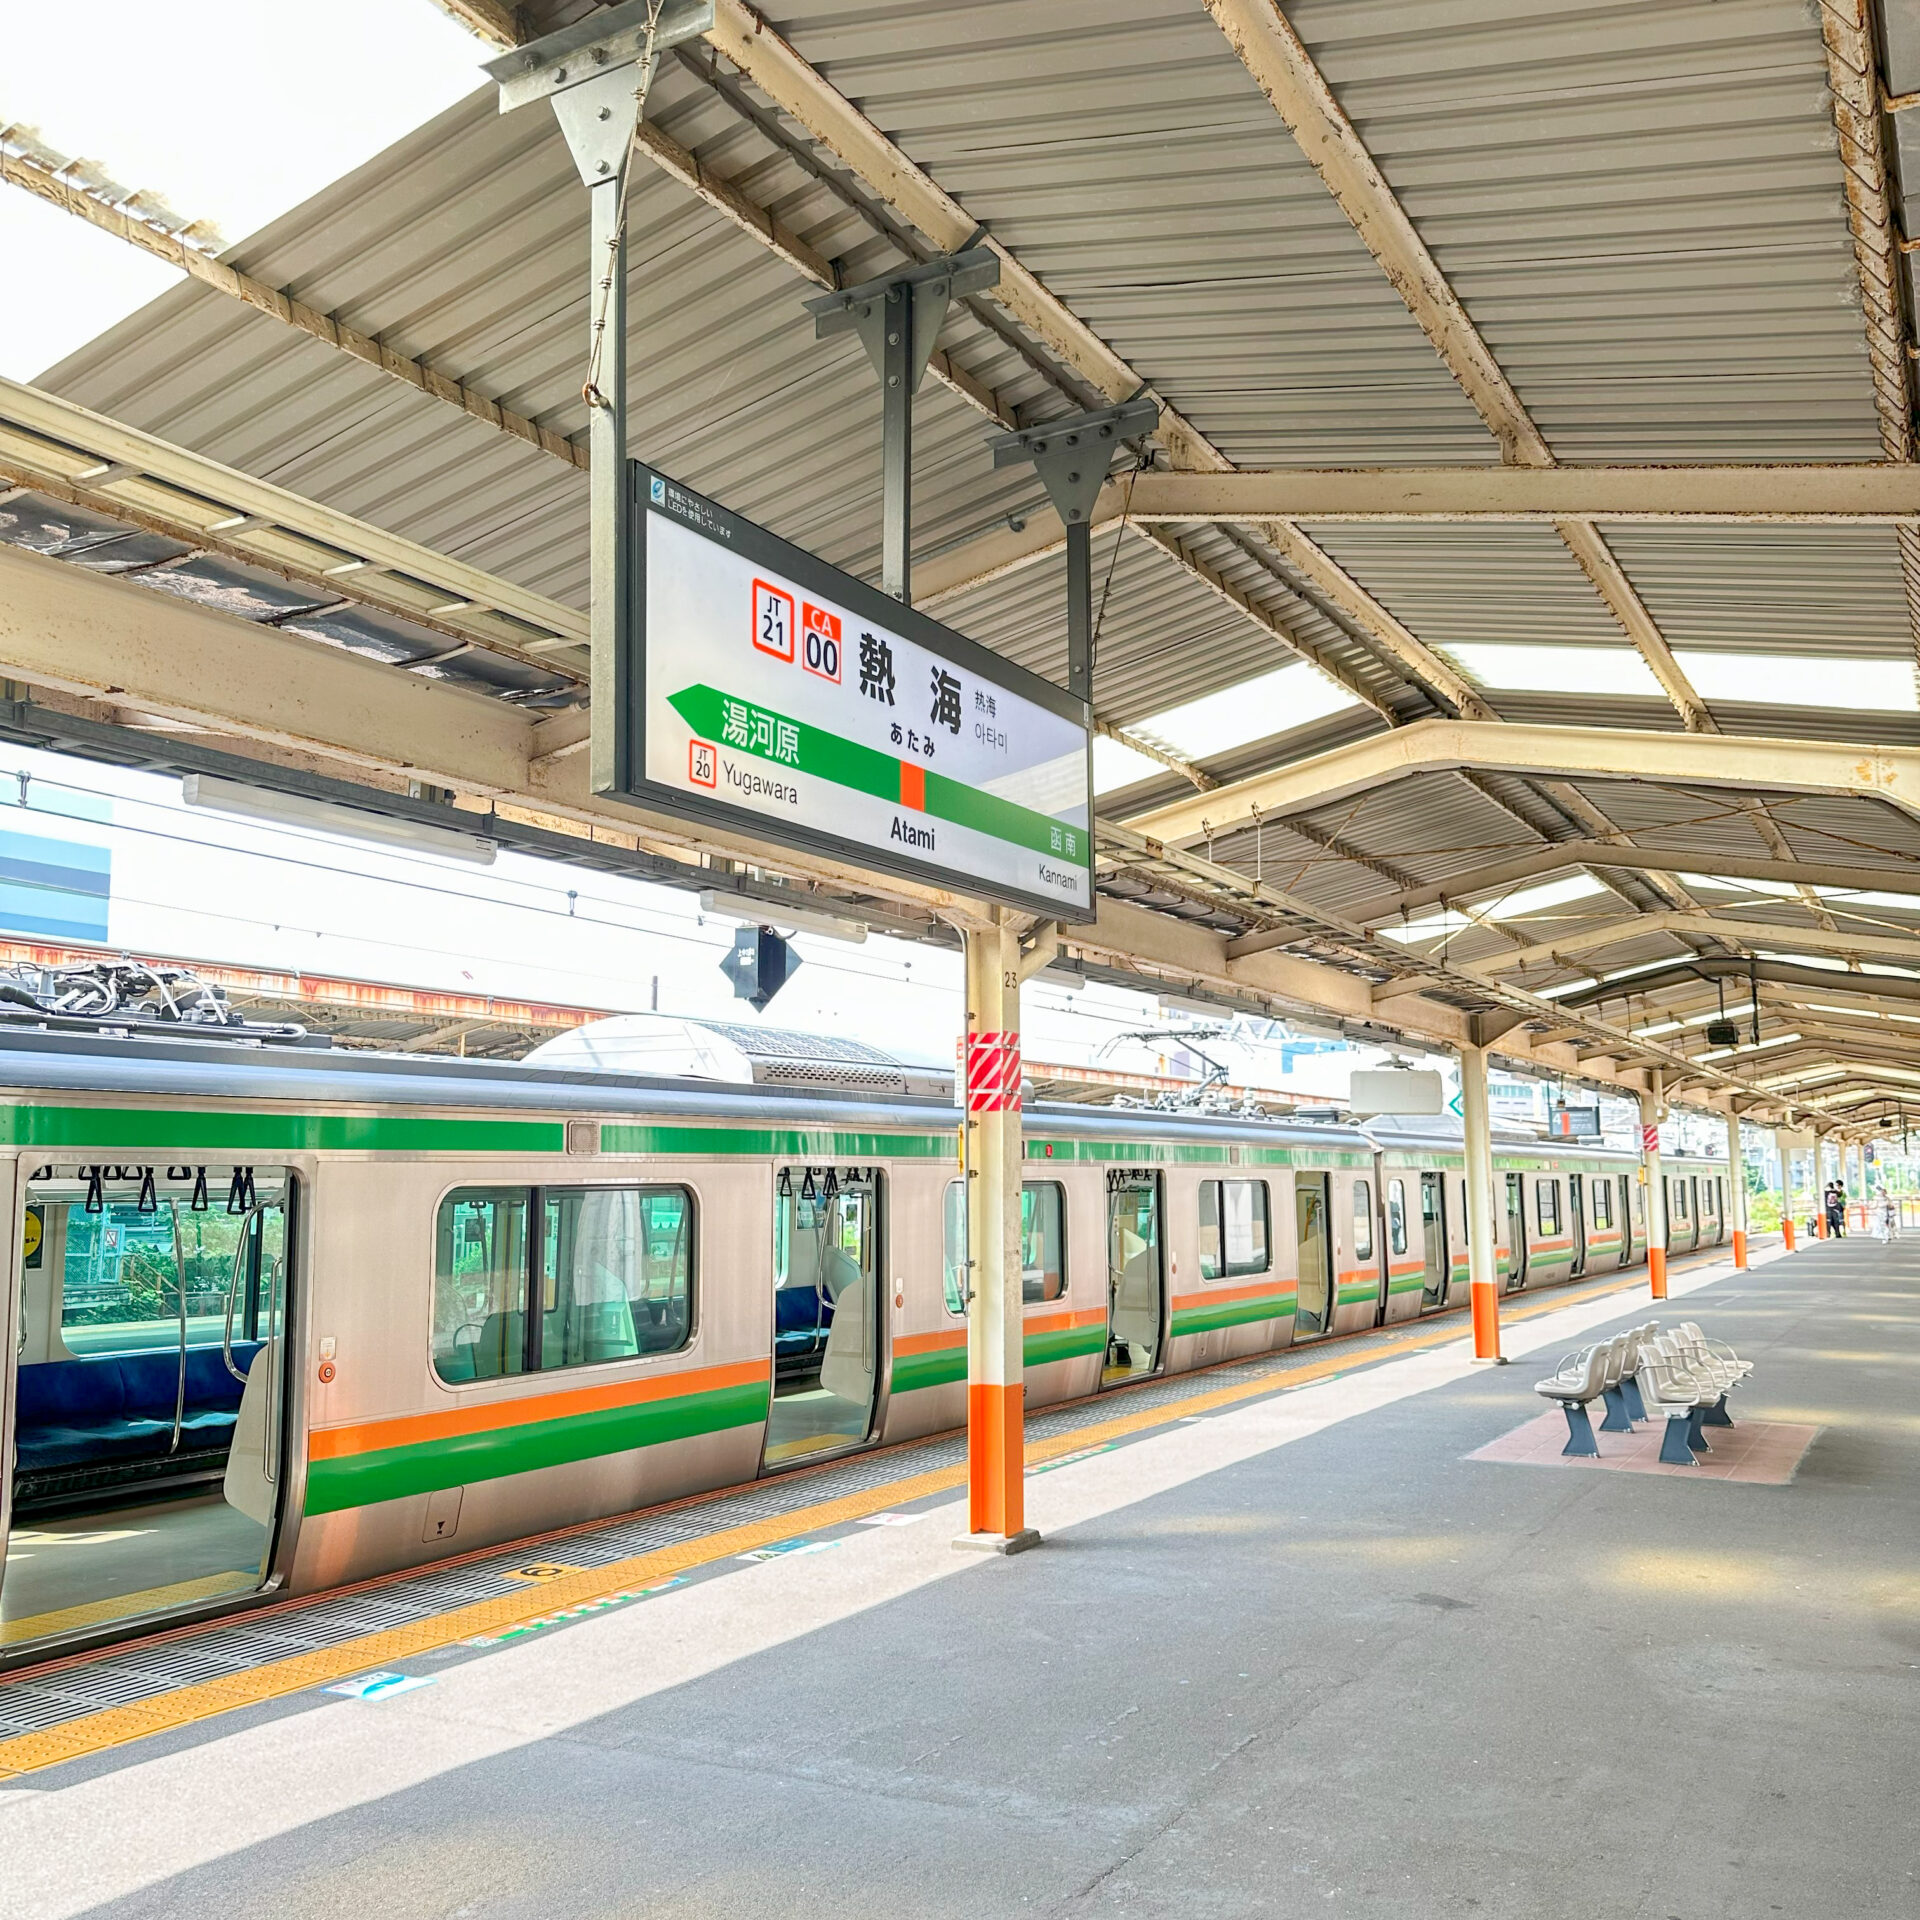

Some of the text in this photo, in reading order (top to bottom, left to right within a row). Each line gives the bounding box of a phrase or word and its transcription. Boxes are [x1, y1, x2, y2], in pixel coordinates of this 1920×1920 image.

[667, 487, 714, 518] 環境にやさしい
[667, 498, 732, 539] LEDを使用しています
[767, 595, 782, 617] JT
[763, 614, 783, 646] 21
[810, 609, 833, 637] CA
[806, 632, 838, 676] 00
[859, 632, 962, 735] 熱海
[721, 698, 801, 765] 湯河原
[890, 722, 936, 758] あたみ
[974, 723, 1008, 754] 아타미
[695, 760, 711, 779] 20
[698, 748, 709, 761] JT
[722, 760, 798, 805] Yugawara
[890, 816, 935, 851] Atami
[1050, 826, 1077, 857] 函南
[1039, 863, 1078, 892] Kannami
[1004, 971, 1018, 990] 23
[1552, 1112, 1562, 1125] 4
